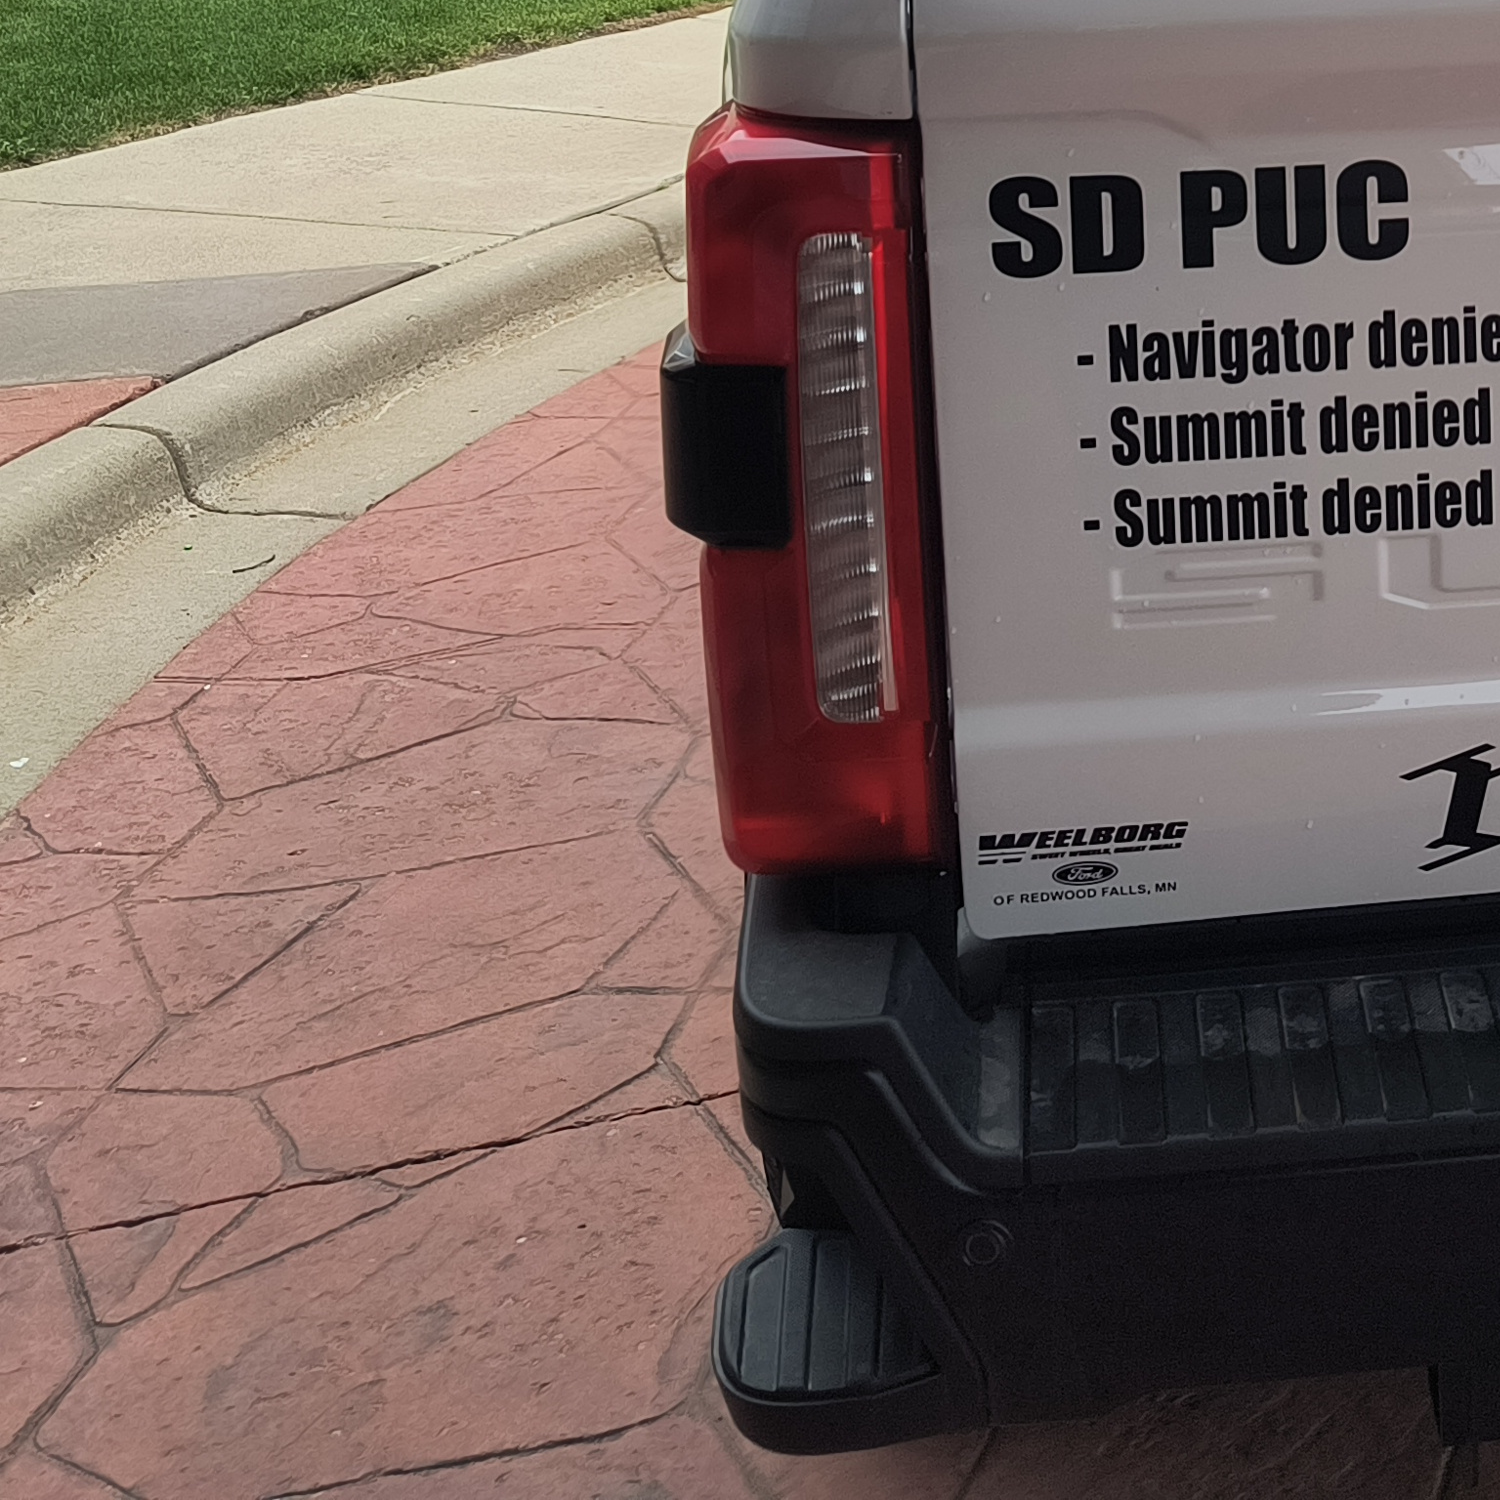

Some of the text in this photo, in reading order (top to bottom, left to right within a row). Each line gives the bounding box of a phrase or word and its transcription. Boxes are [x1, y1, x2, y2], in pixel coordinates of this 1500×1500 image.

[988, 159, 1410, 278] SD PUC
[1108, 319, 1354, 384] Navigator
[1110, 399, 1307, 466] Summit
[1319, 387, 1492, 454] denied
[1113, 481, 1310, 548] Summit
[1322, 469, 1494, 536] denied
[978, 820, 1189, 851] WEELBORG
[993, 881, 1177, 906] OF REDWOOD FALLS, MN
[1067, 866, 1104, 881] Ford
